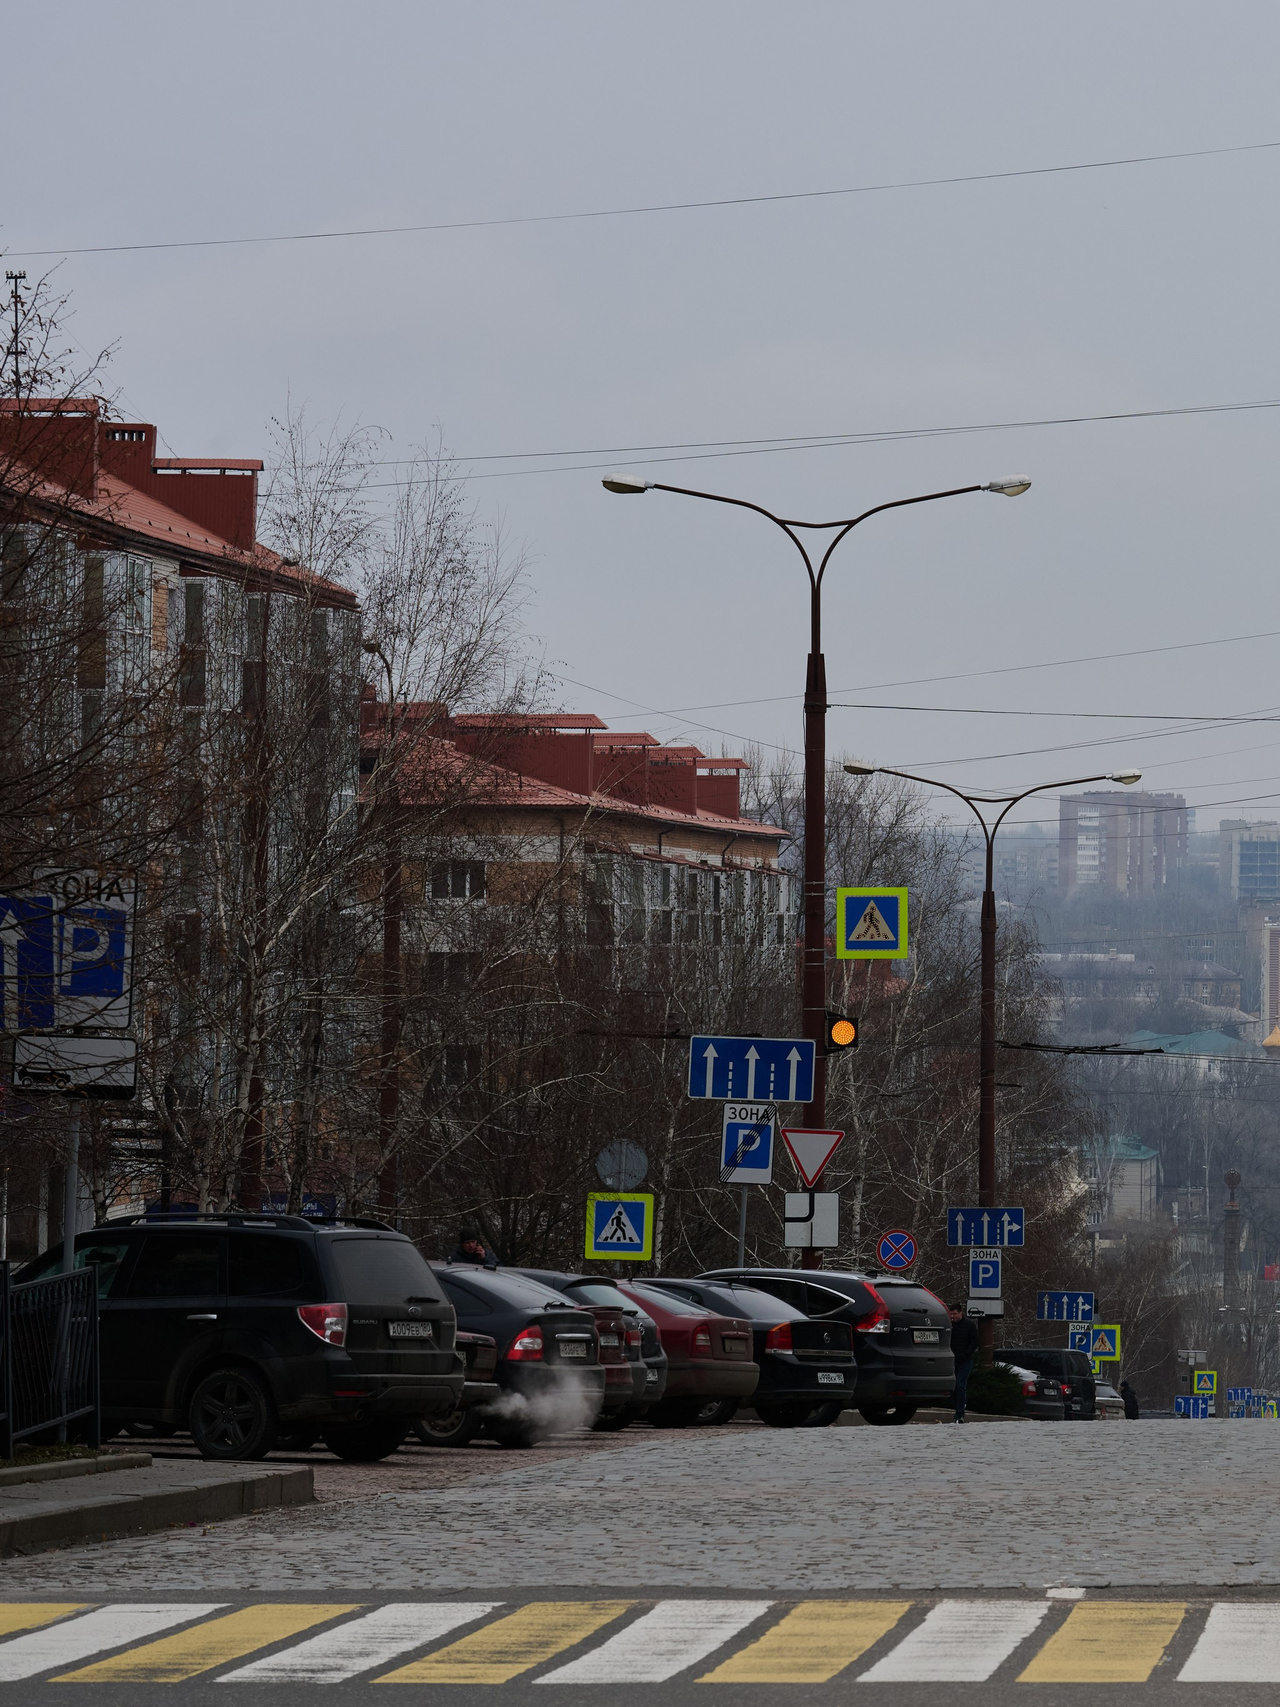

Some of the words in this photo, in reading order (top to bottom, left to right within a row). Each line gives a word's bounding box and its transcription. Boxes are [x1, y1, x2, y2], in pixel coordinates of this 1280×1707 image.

[61, 917, 110, 986] P
[728, 1107, 770, 1121] ЗОНА
[736, 1129, 761, 1164] P
[972, 1250, 999, 1259] ЗОНА
[978, 1264, 994, 1286] P
[1075, 1335, 1087, 1350] P
